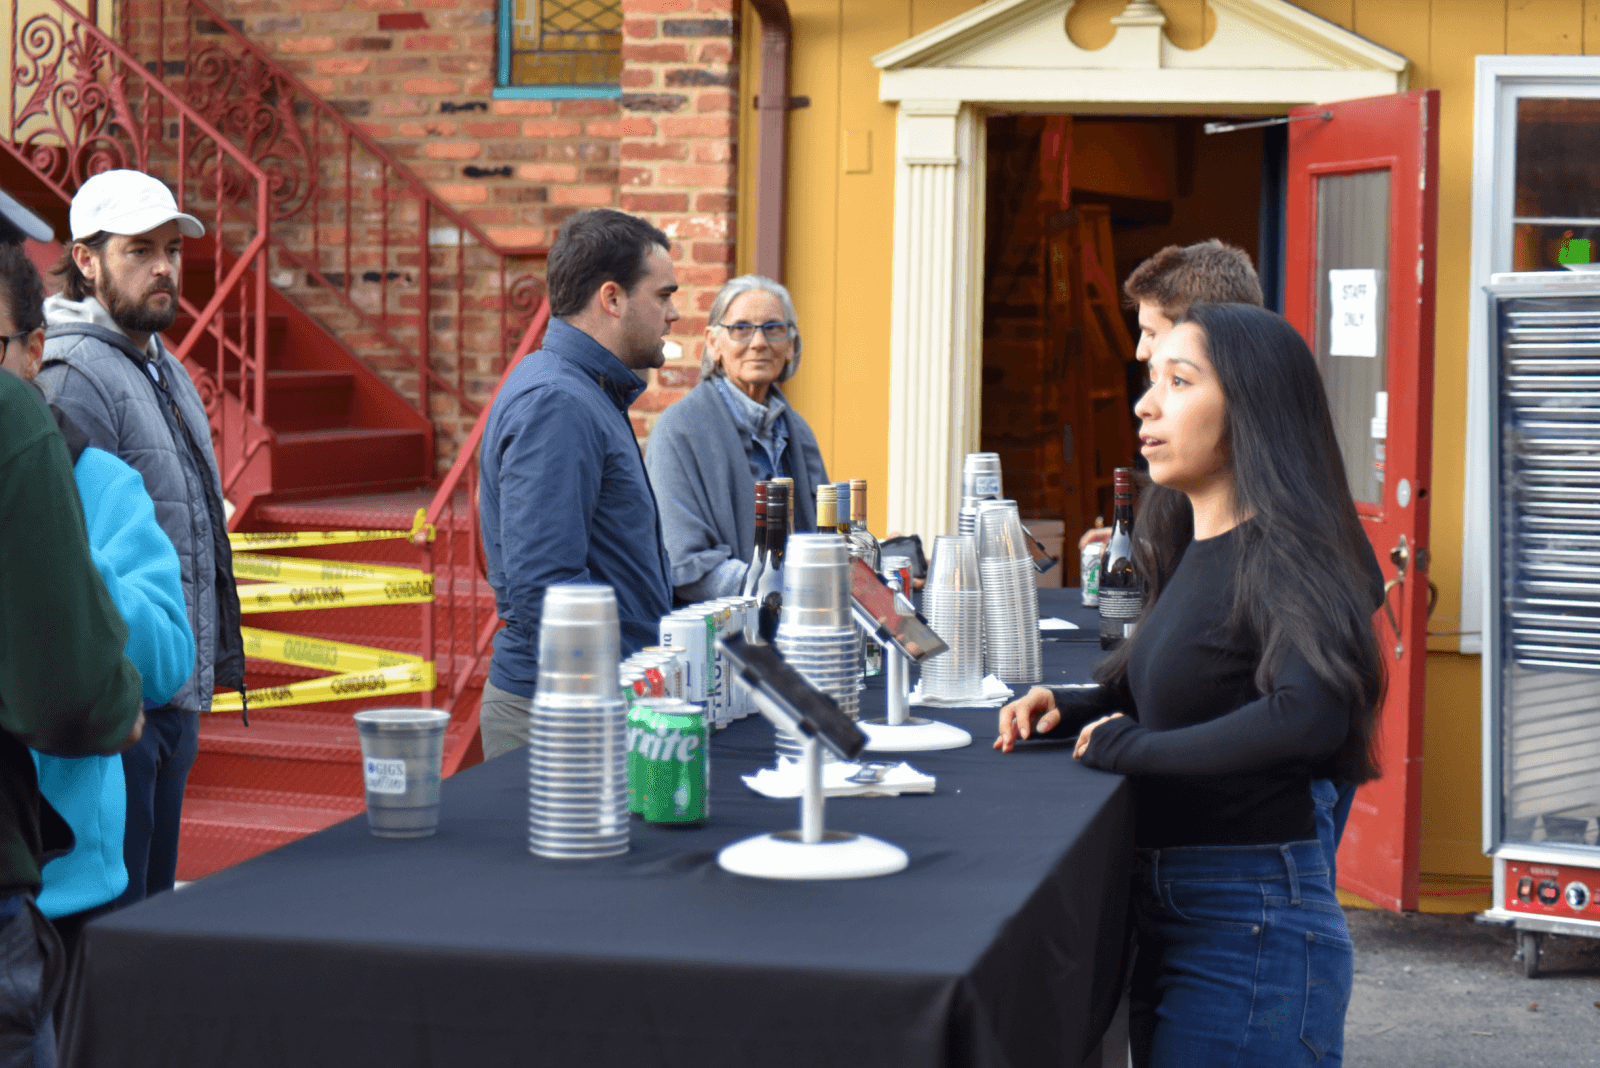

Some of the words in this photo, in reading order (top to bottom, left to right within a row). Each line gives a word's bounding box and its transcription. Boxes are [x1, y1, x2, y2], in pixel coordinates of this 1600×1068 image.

[1342, 283, 1367, 301] STAFF
[289, 585, 345, 605] CAUTION
[384, 580, 433, 599] CUIDAD
[331, 674, 387, 695] CUIDADO
